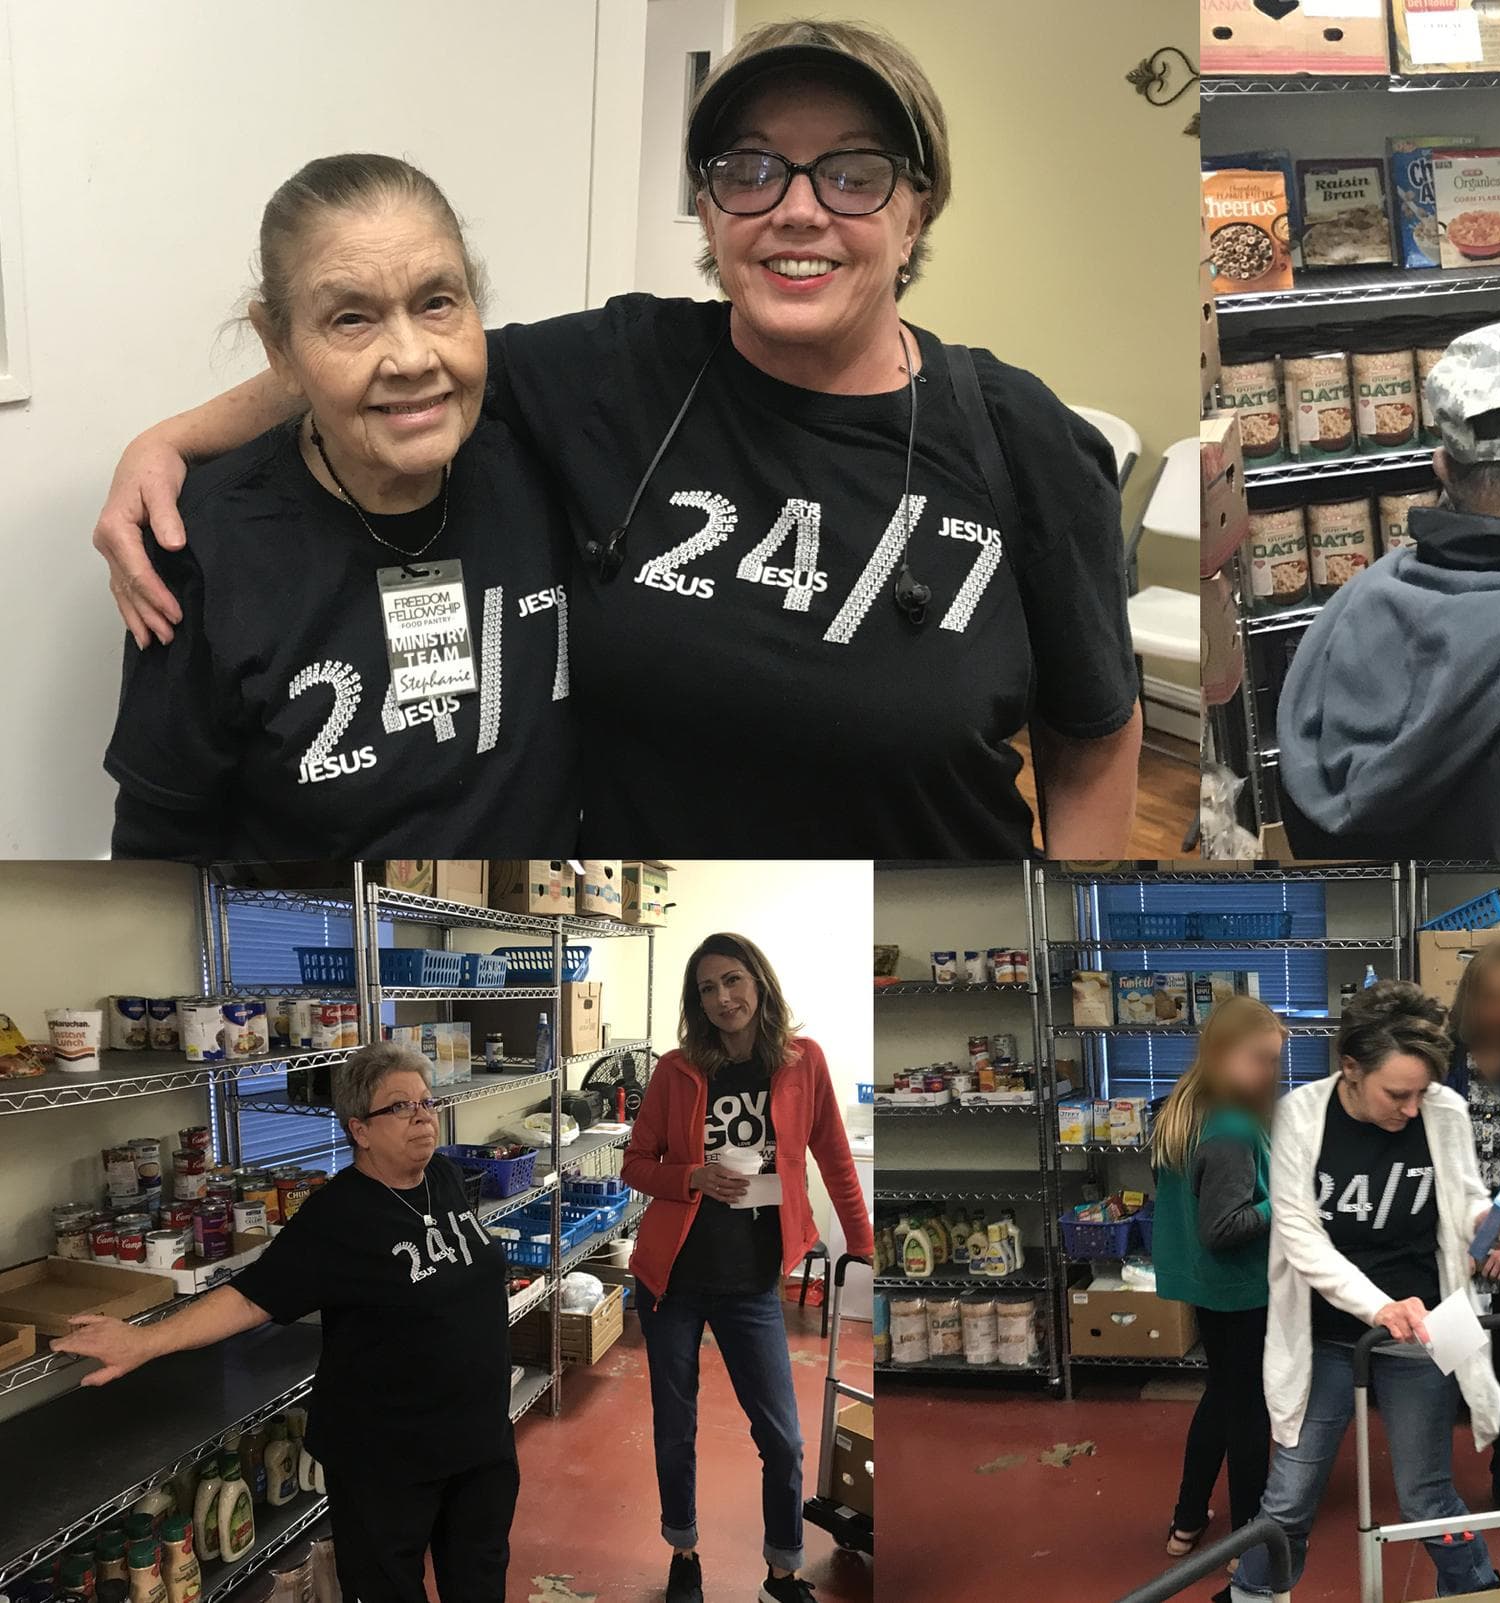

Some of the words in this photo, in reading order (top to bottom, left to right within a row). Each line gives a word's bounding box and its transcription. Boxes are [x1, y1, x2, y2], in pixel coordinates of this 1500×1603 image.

[1315, 175, 1371, 191] Raisin
[1407, 157, 1433, 189] Ch
[1323, 189, 1366, 202] Bran
[1221, 388, 1278, 409] OATS
[1300, 384, 1350, 404] OATS
[1359, 380, 1412, 398] OATS
[938, 517, 1002, 549] JESUS
[1310, 530, 1365, 548] OATS
[1253, 536, 1307, 559] OATS
[634, 564, 716, 600] JESUS
[749, 566, 829, 593] JESUS
[394, 591, 451, 610] FREEDOM
[517, 585, 567, 618] JESUS
[388, 602, 461, 623] FELLOWSHIP
[401, 621, 422, 629] FOOD
[424, 617, 452, 626] PANTRY
[391, 627, 467, 653] MINISTRY
[403, 646, 460, 668] TEAM
[400, 670, 471, 694] Stephanie
[397, 696, 461, 732] JESUS
[298, 746, 377, 784] JESUS
[53, 1030, 87, 1039] Instant
[56, 1039, 85, 1047] Lunch
[392, 1210, 491, 1281] 24/7
